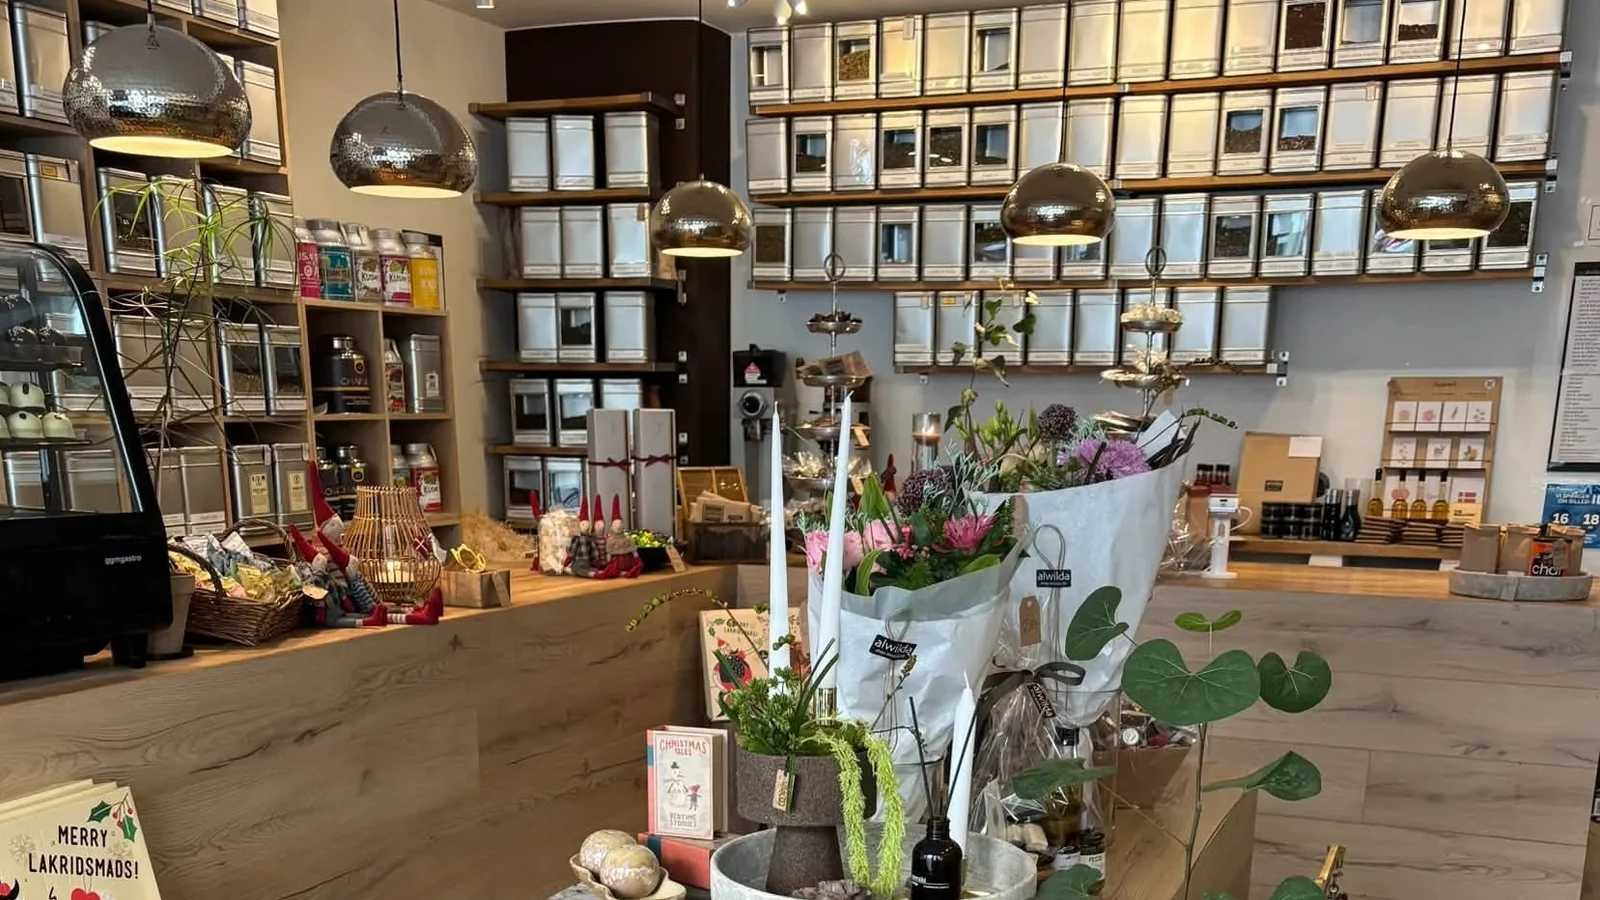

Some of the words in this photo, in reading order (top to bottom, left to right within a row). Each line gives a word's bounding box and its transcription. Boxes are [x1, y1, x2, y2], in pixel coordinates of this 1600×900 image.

[1552, 512, 1570, 525] 16
[1583, 513, 1600, 526] 18
[1037, 571, 1070, 581] alwilda
[874, 639, 913, 657] alwilda
[659, 739, 707, 755] CHRISTMAS
[674, 748, 692, 757] TALES
[58, 825, 108, 848] MERRY
[29, 852, 139, 879] LAKRIDSMADS!
